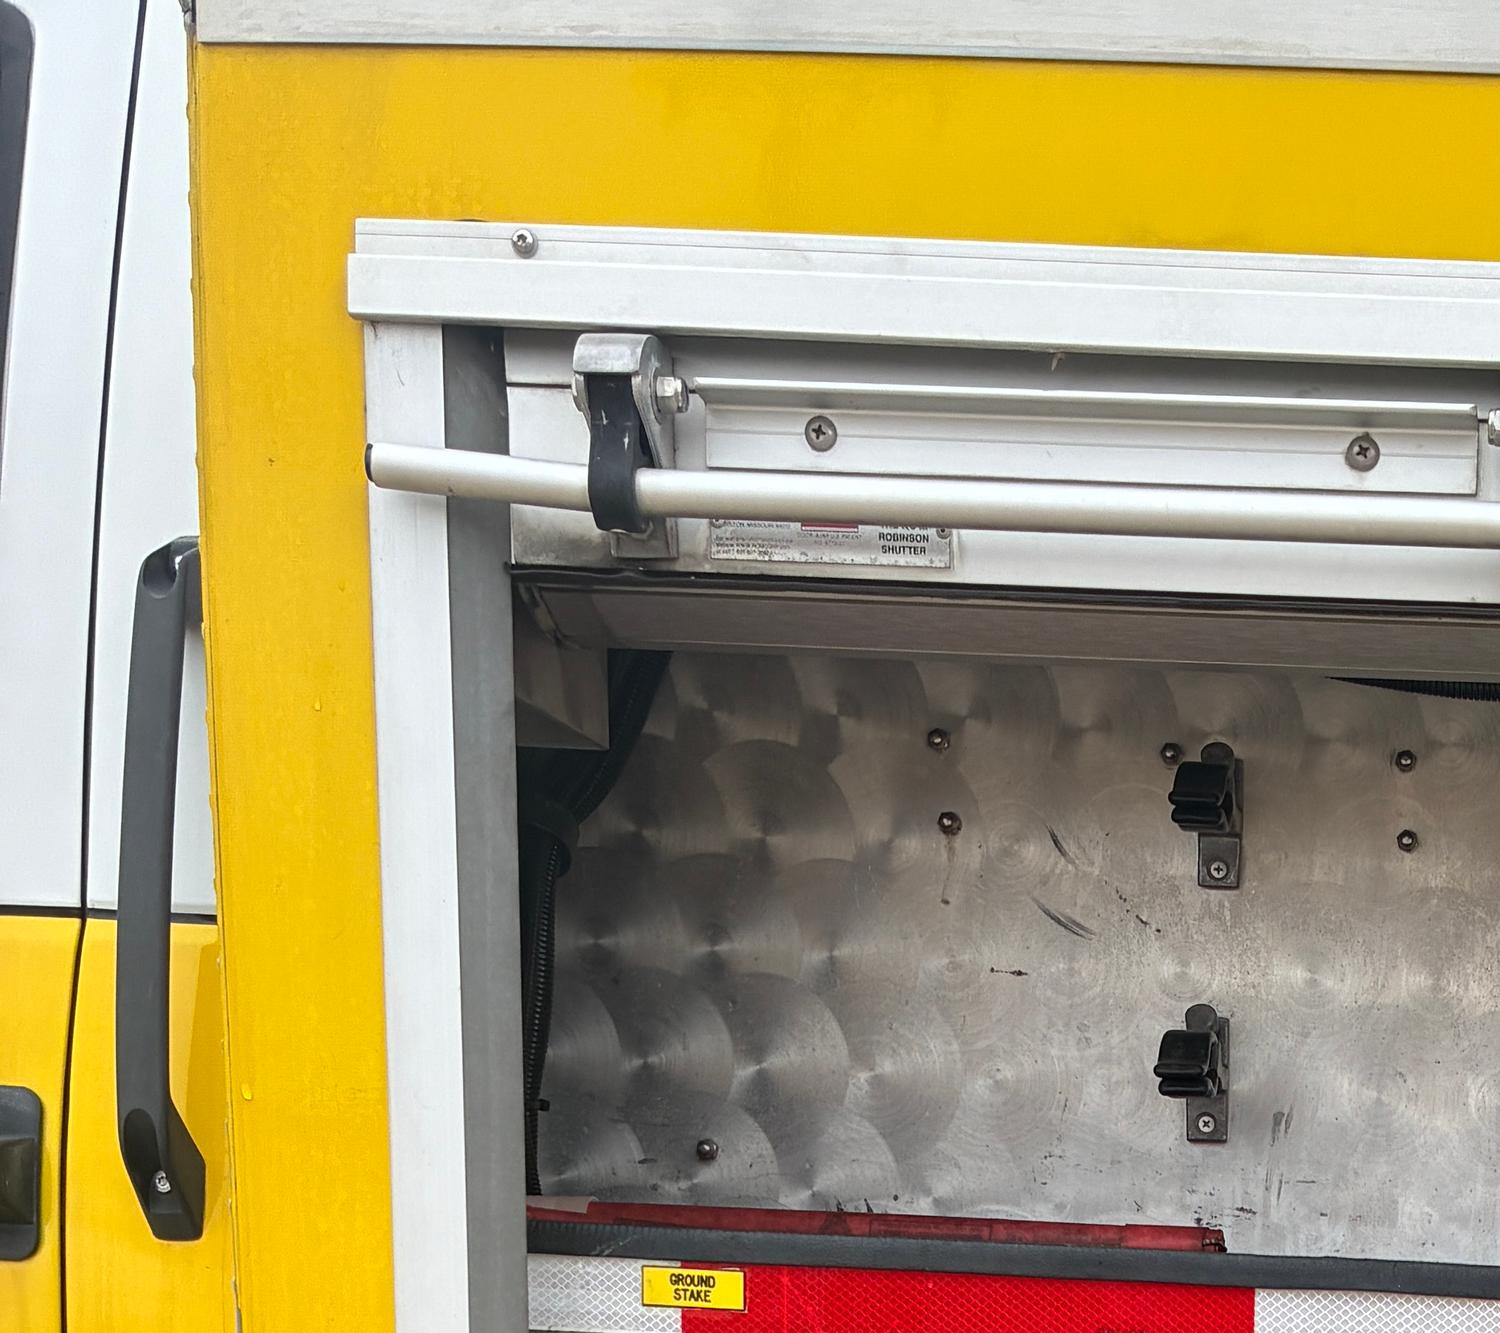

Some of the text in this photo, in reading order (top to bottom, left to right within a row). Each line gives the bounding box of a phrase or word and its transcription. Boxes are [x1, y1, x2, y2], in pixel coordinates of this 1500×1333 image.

[878, 532, 929, 543] ROBINSON
[881, 545, 926, 555] SHUTTER
[669, 1273, 716, 1288] GROUND
[673, 1288, 712, 1303] STAKE
